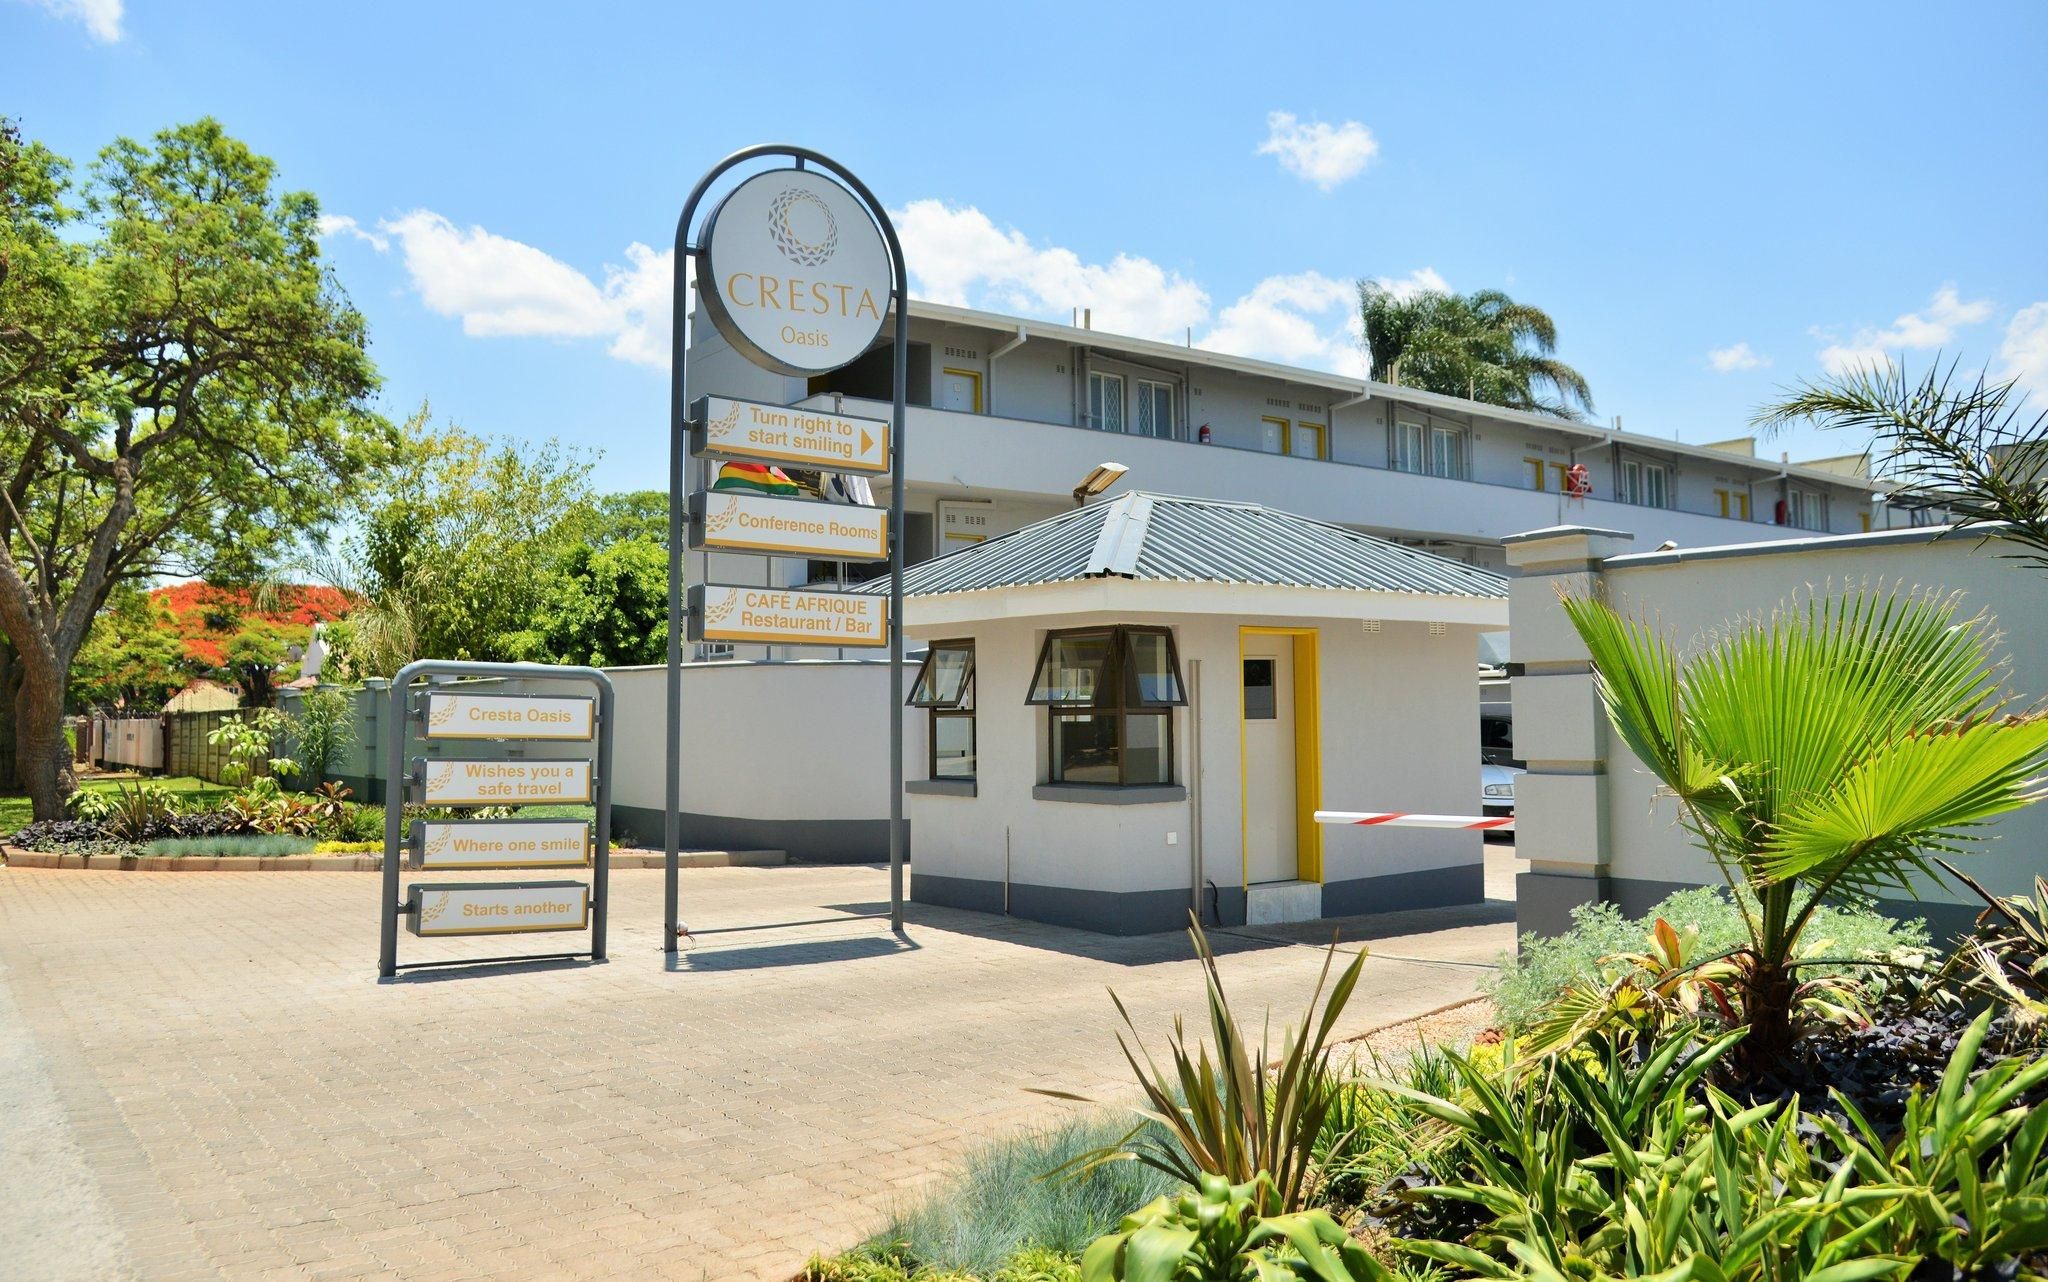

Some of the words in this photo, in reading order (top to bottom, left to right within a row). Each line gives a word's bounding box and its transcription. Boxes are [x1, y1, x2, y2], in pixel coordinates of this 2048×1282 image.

[727, 273, 880, 320] CRESTA
[781, 325, 829, 347] Oasis
[750, 407, 788, 427] Turn
[794, 415, 831, 434] right
[836, 420, 852, 436] to
[748, 429, 788, 446] start
[793, 435, 853, 458] smiling
[738, 512, 824, 534] Conference
[829, 522, 878, 540] Rooms
[746, 592, 791, 610] CAFÉ
[795, 596, 867, 615] AFRIQUE
[741, 611, 831, 631] Restaurant
[835, 617, 840, 631] /
[845, 617, 873, 634] Bar
[469, 707, 522, 722] Cresta
[527, 709, 572, 723] Oasis
[466, 764, 525, 778] Wishes
[531, 767, 560, 780] you
[565, 767, 574, 777] a
[478, 782, 512, 795] safe
[518, 782, 562, 795] travel
[453, 839, 503, 852] Where
[508, 840, 536, 851] one
[540, 838, 580, 850] smile
[463, 903, 508, 917] Starts
[514, 901, 572, 915] another
